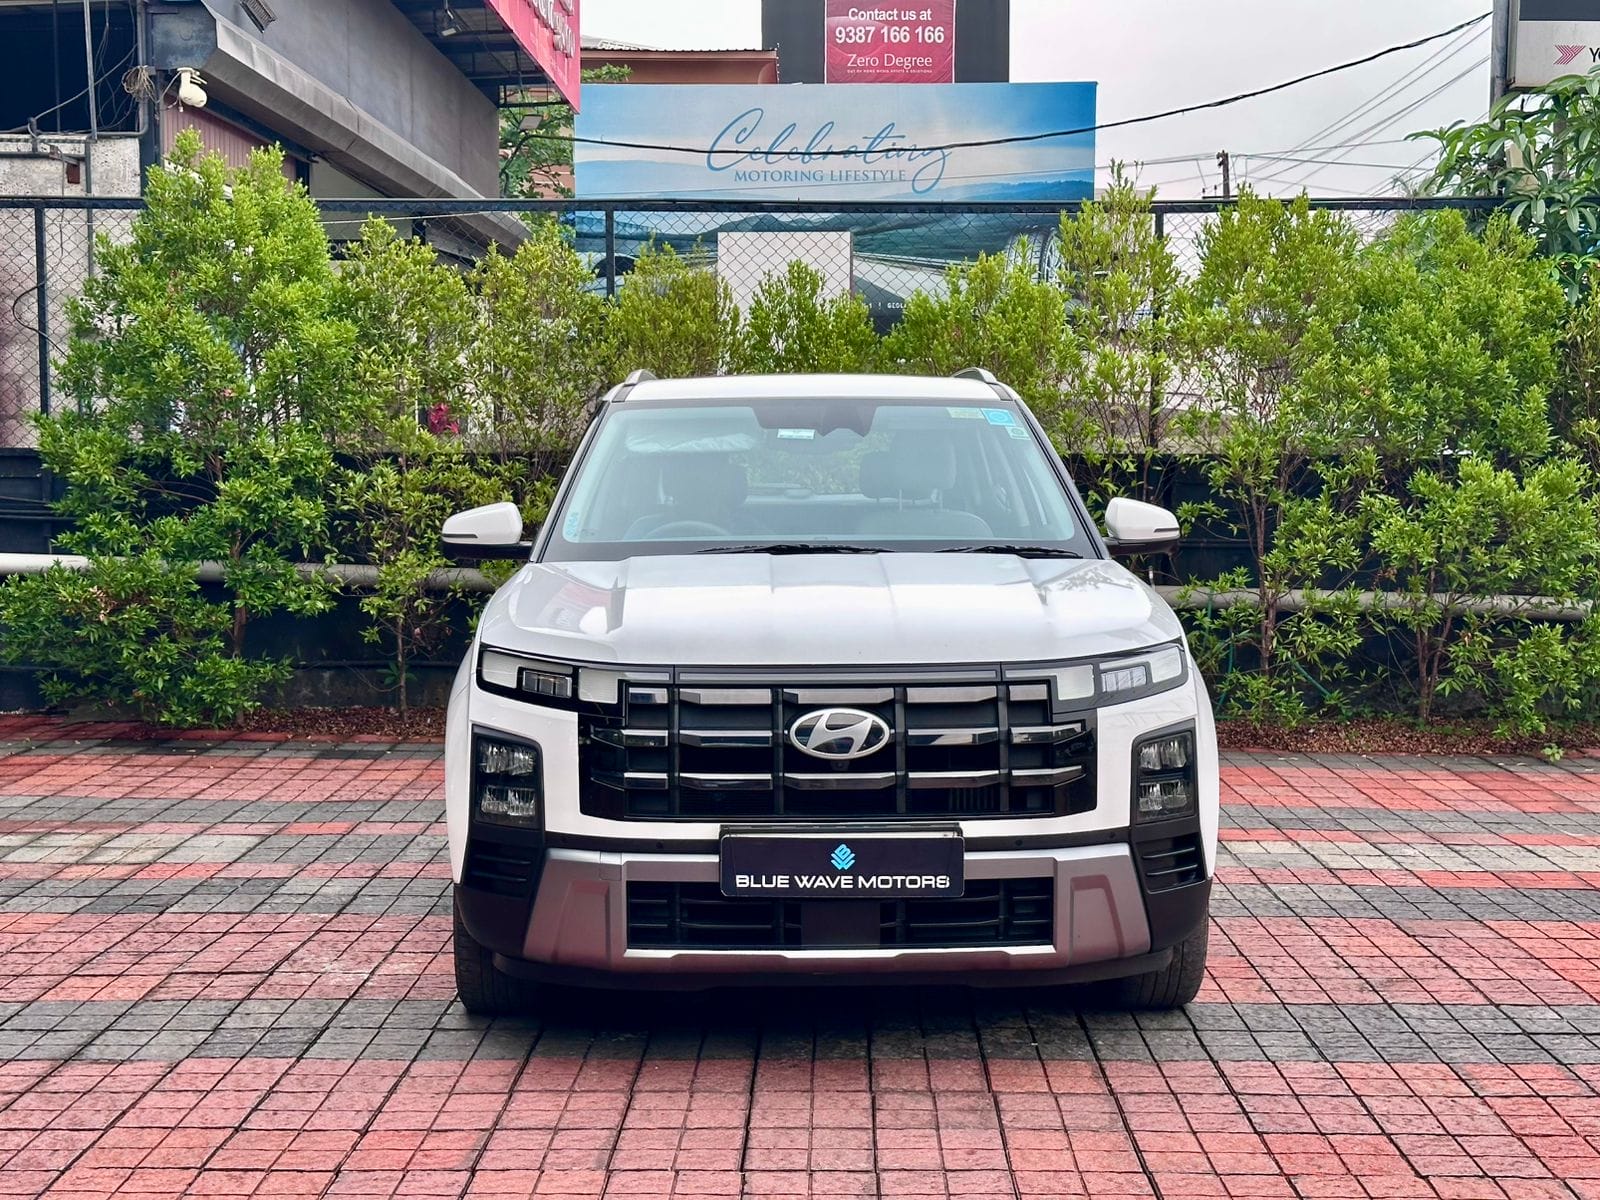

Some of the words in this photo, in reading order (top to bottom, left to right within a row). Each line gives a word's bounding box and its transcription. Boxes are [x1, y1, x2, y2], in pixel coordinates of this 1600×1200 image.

[848, 7, 898, 21] Contact
[901, 10, 917, 21] us
[919, 8, 932, 21] at
[835, 26, 875, 43] 9387
[880, 26, 911, 43] 166
[914, 26, 945, 43] 166
[847, 53, 879, 67] Zero
[884, 53, 932, 69] Degree
[1588, 47, 1600, 63] Y
[707, 107, 952, 194] Celebrating
[734, 170, 824, 182] MOTORING
[830, 170, 907, 182] LIFESTYLE
[735, 875, 790, 889] BLUE
[794, 875, 854, 889] WAVE
